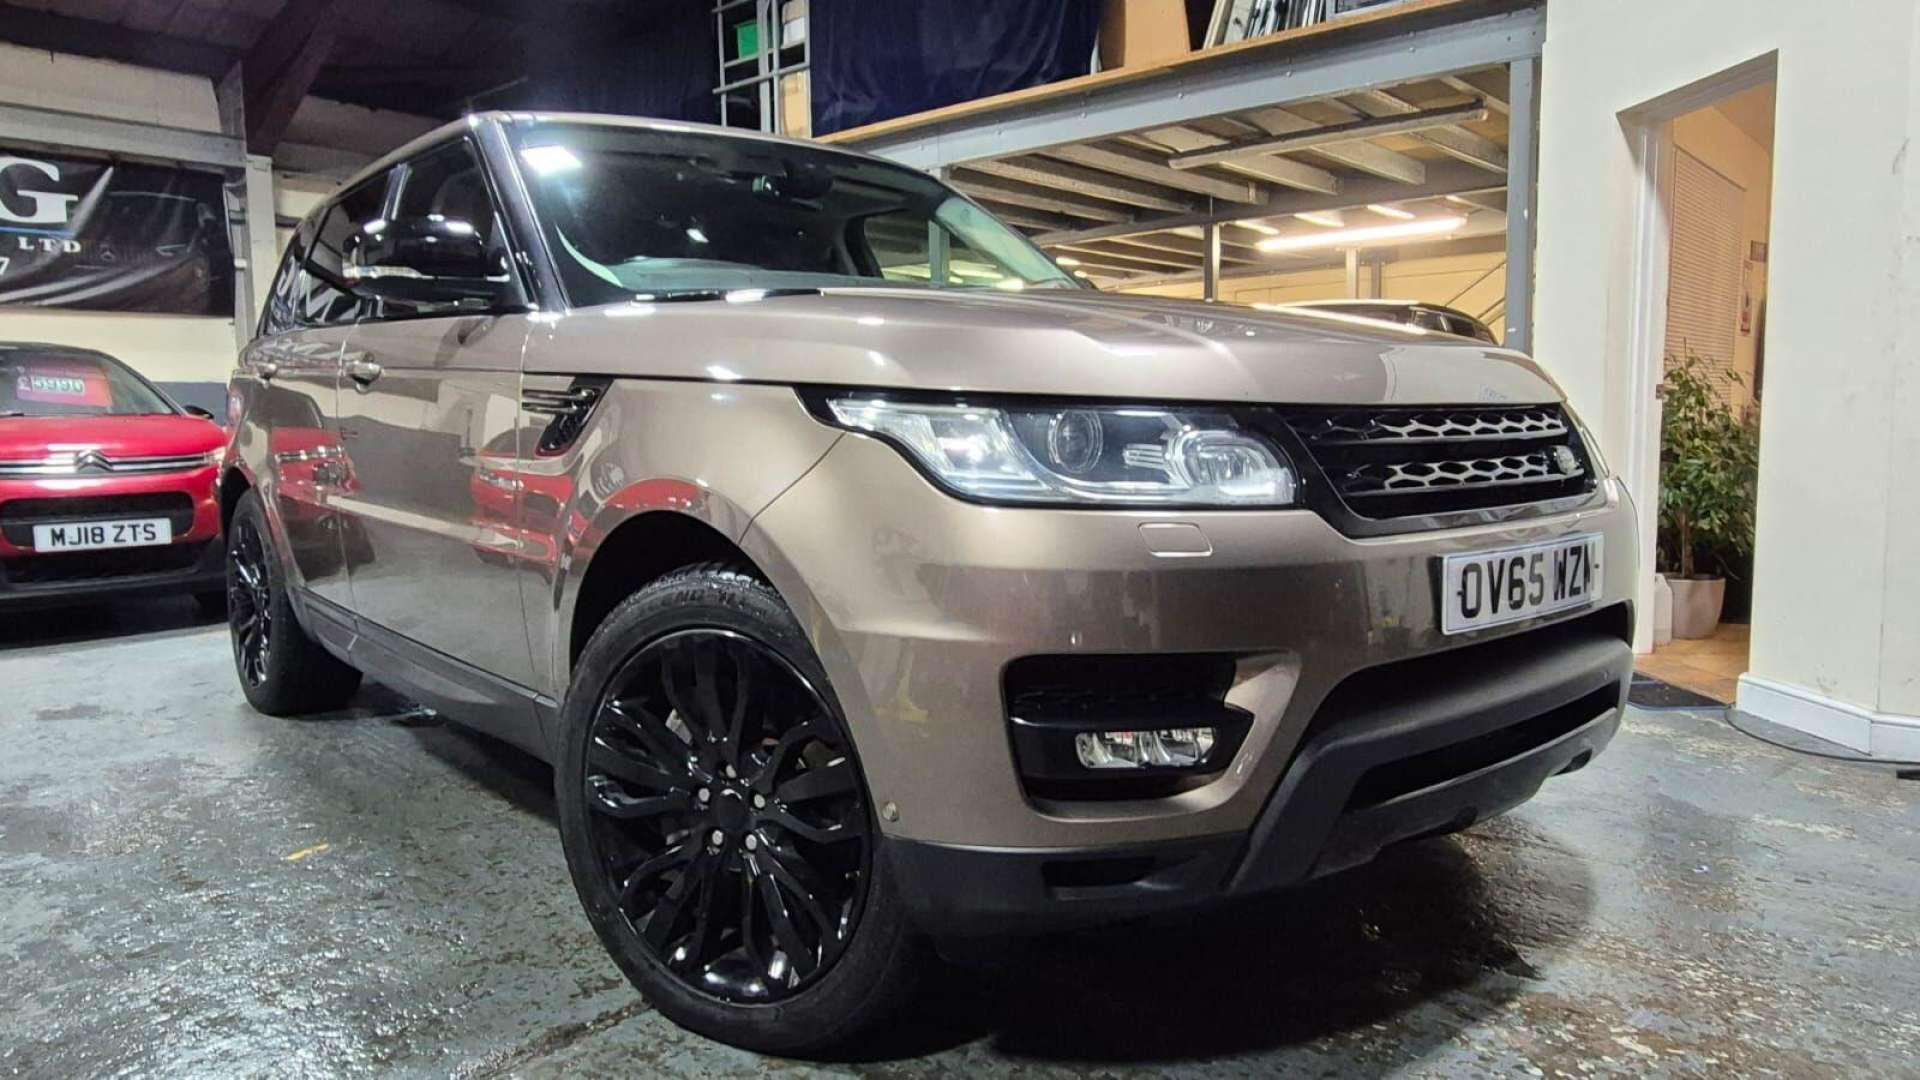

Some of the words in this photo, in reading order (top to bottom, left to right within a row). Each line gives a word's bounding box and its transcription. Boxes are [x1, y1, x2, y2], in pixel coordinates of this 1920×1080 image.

[0, 156, 78, 223] G
[18, 237, 81, 253] LTD
[51, 526, 104, 547] MJ18
[113, 524, 156, 542] ZTS
[1461, 553, 1544, 619] OV65
